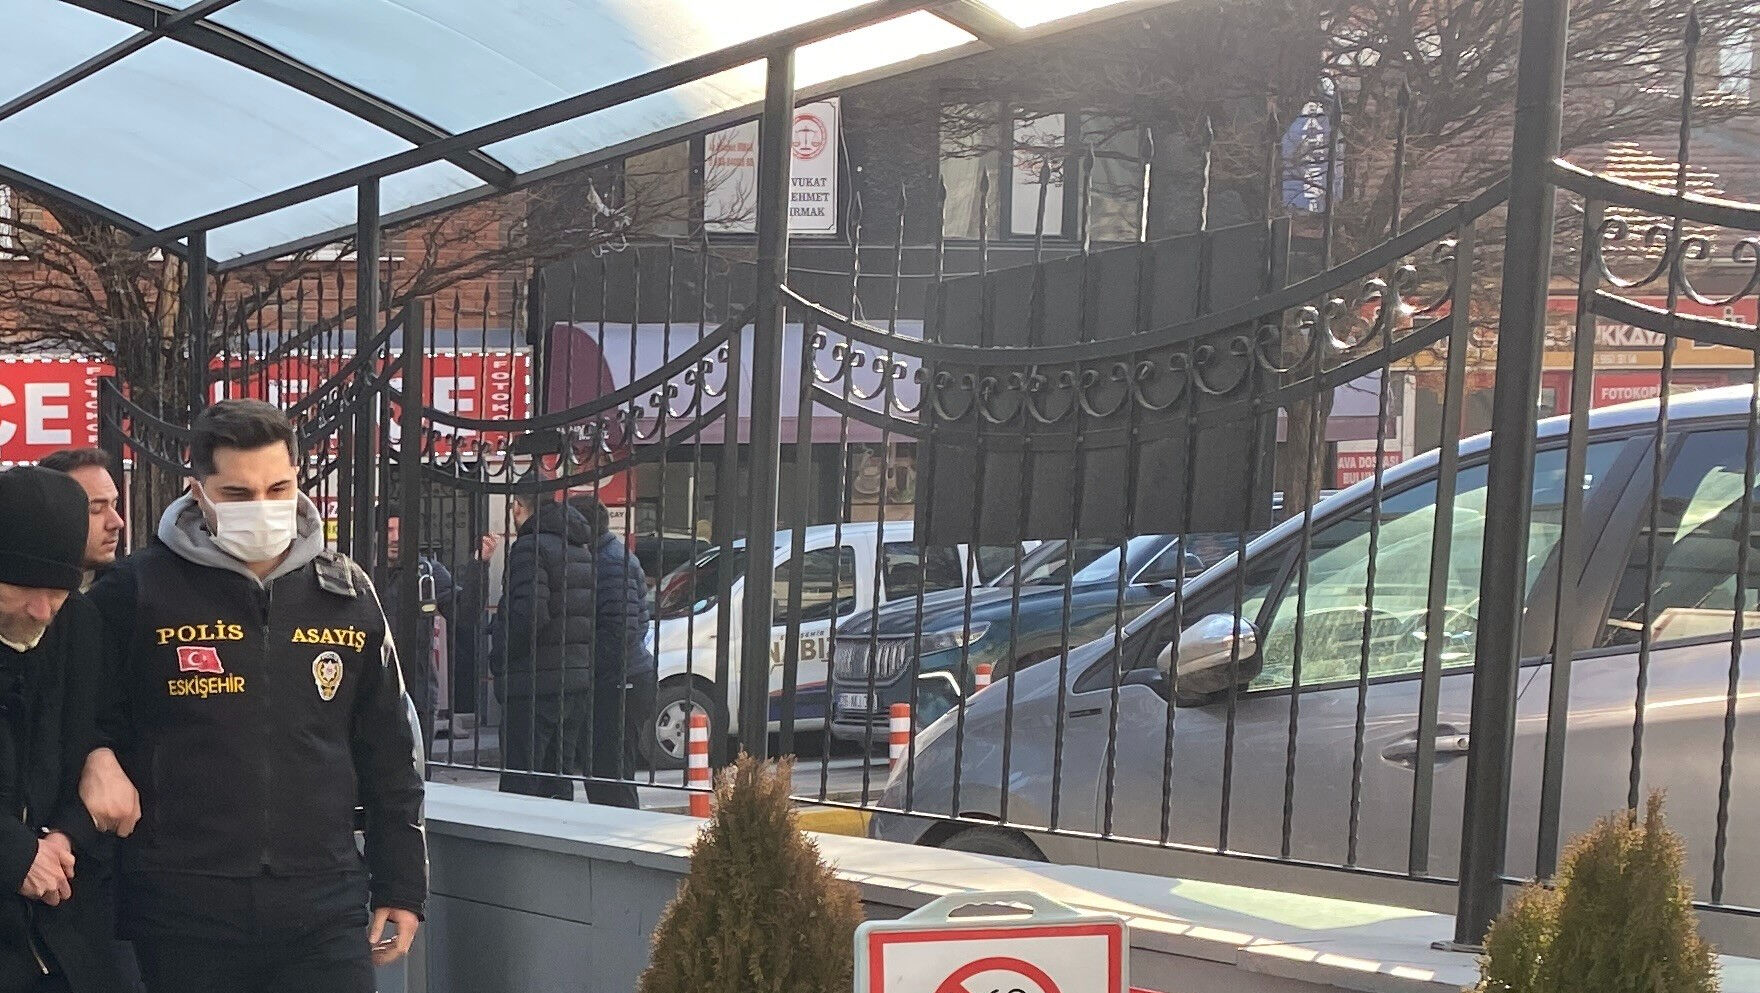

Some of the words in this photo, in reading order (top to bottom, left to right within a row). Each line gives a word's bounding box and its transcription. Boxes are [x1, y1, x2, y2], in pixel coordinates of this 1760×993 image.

[791, 177, 827, 187] VUKAT
[791, 193, 830, 202] EHMET
[156, 620, 244, 645] POLİS
[292, 625, 366, 652] ASAYİŞ
[168, 673, 245, 698] ESKİŞEHİR
